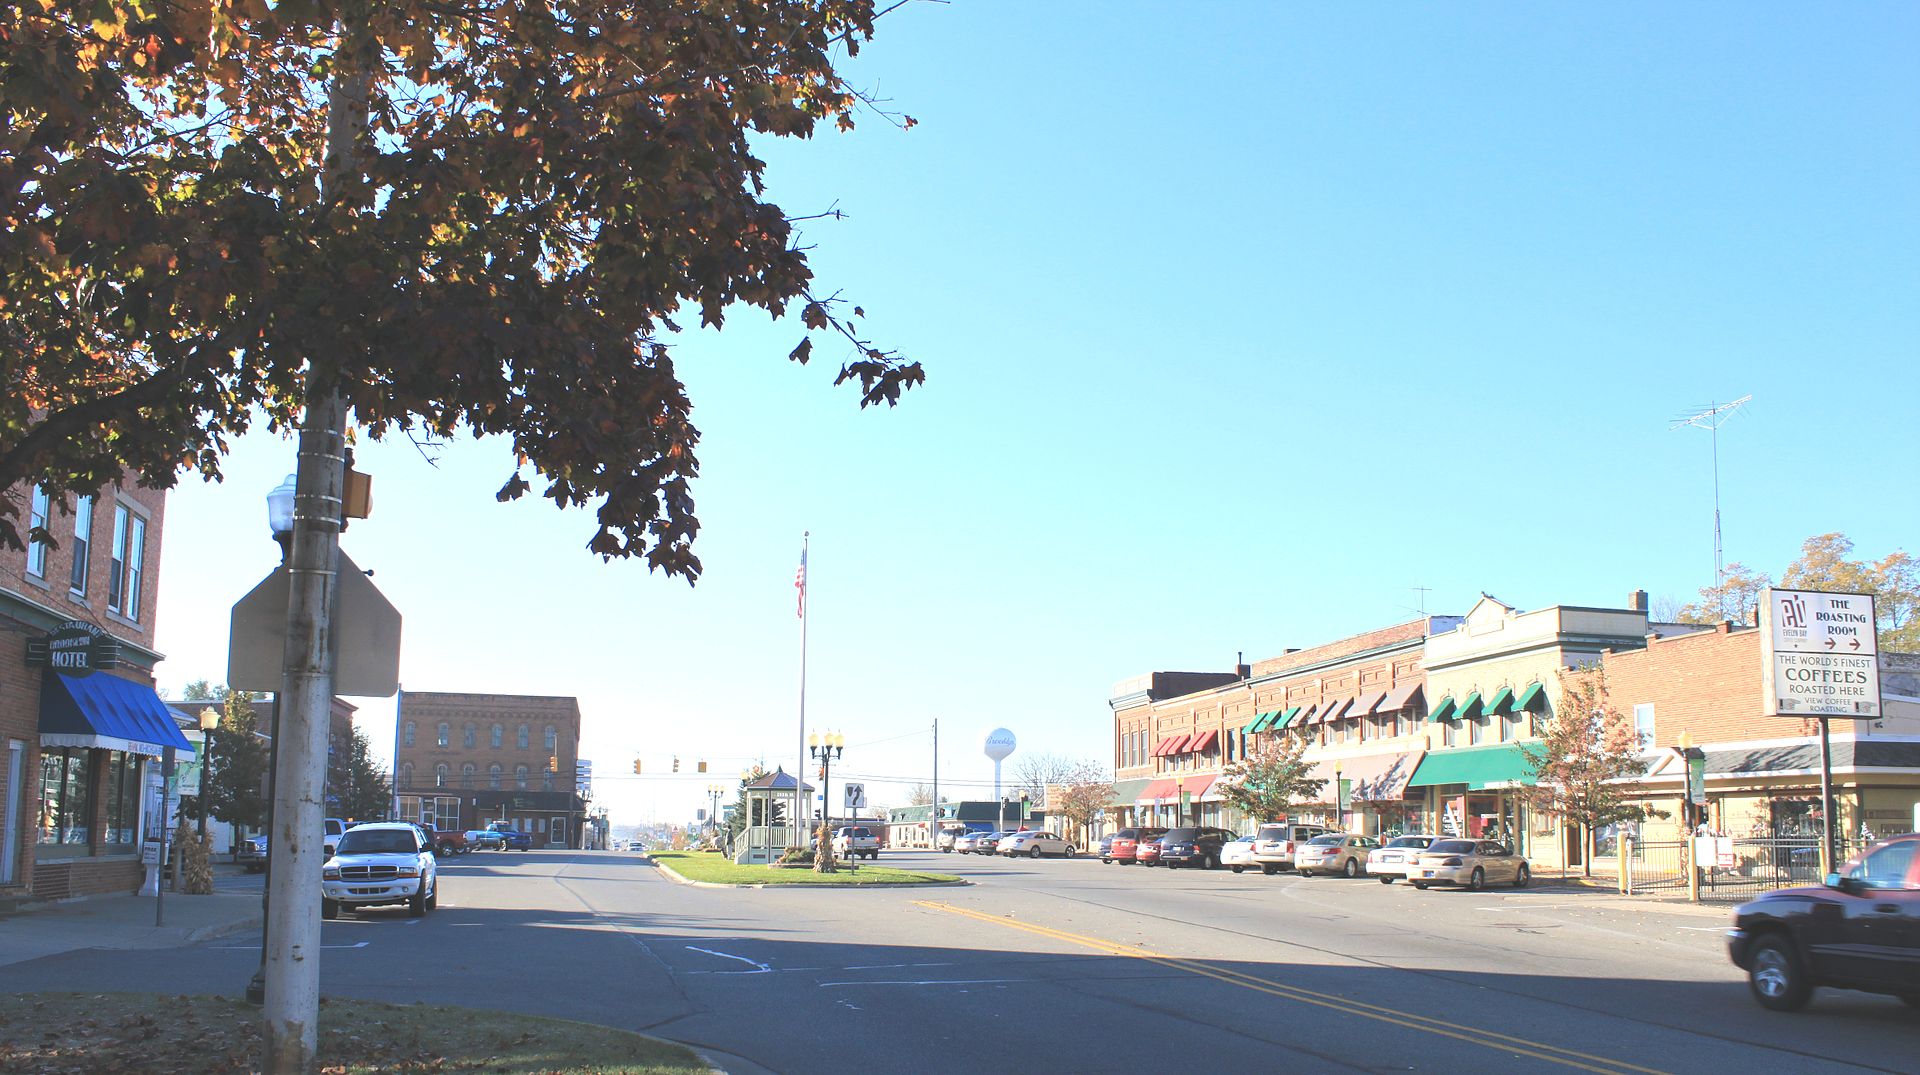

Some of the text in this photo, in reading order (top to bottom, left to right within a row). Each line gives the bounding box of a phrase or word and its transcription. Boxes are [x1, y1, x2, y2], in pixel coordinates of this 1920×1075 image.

[1830, 599, 1850, 610] THE
[1816, 612, 1866, 623] ROASTING
[1827, 625, 1857, 636] ROOM
[52, 651, 89, 668] HOTEL
[1779, 655, 1871, 668] THE WORLD'S FINEST
[1785, 668, 1867, 684] COFFEES
[1789, 684, 1865, 696] ROASTED HERE
[1809, 705, 1847, 713] ROASTING
